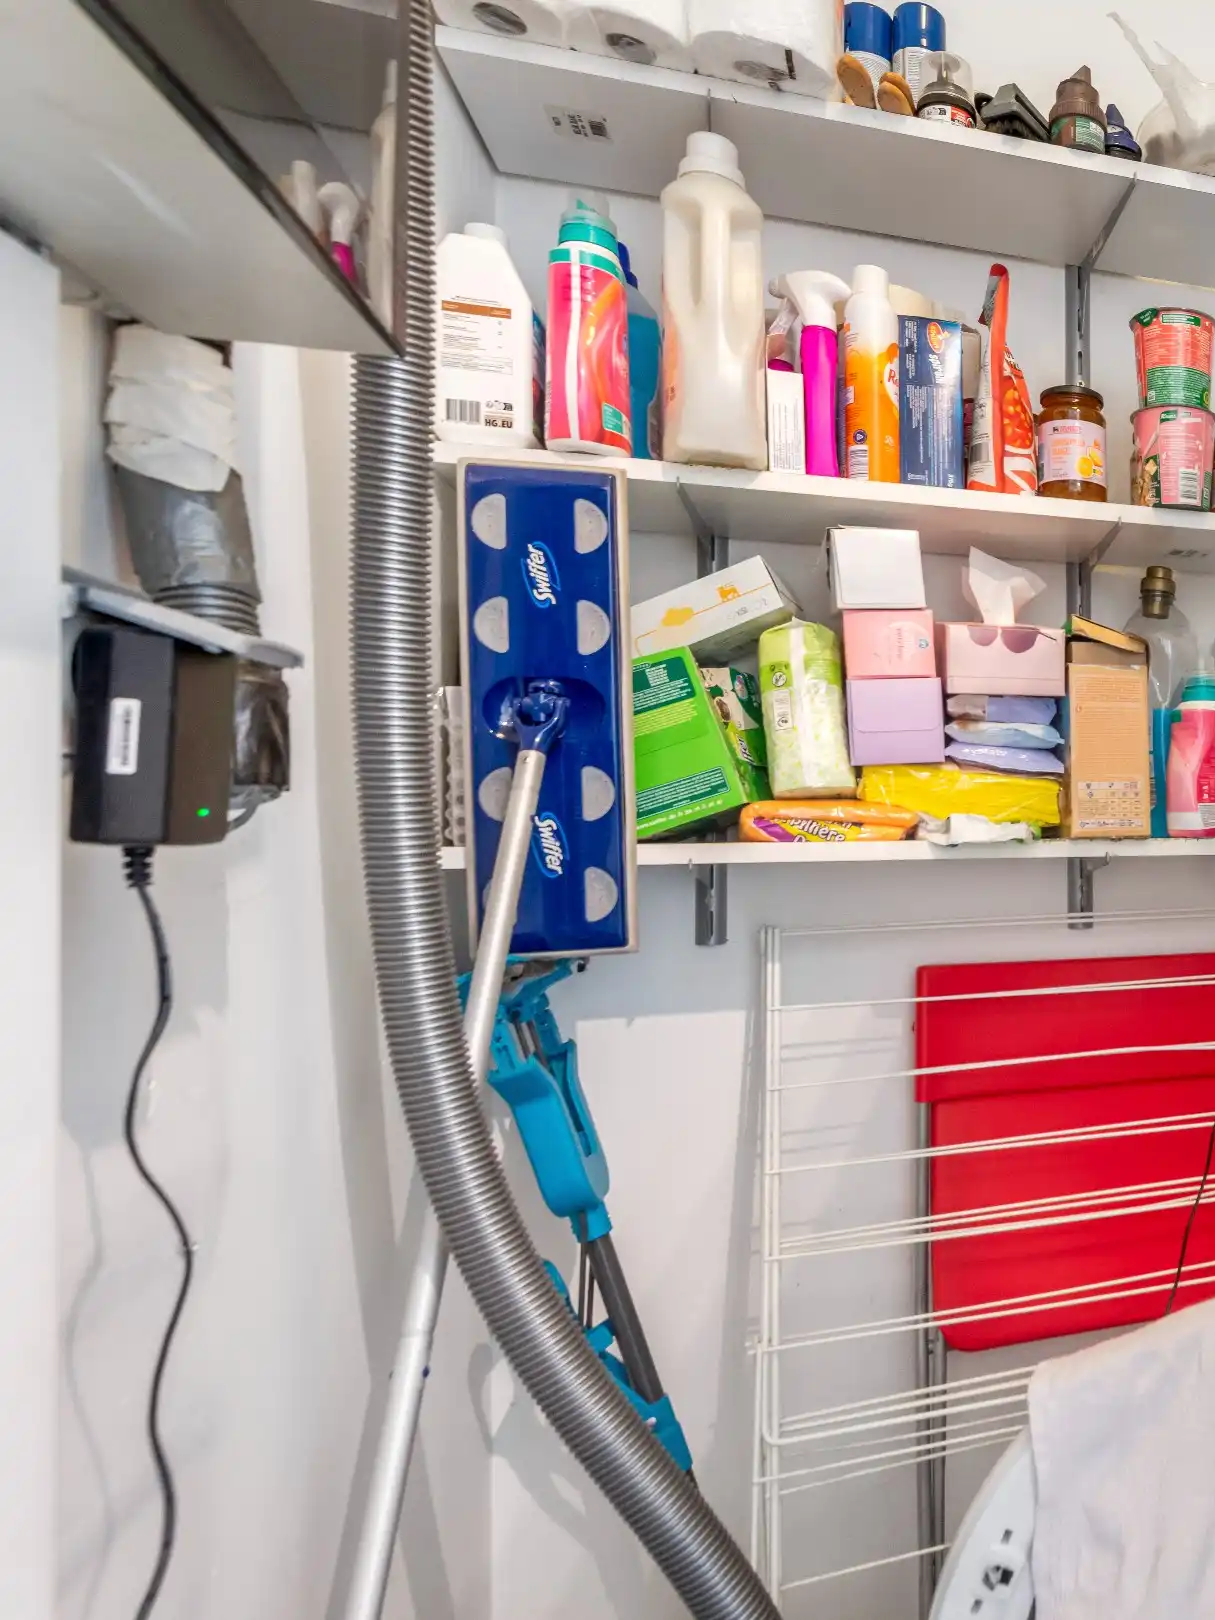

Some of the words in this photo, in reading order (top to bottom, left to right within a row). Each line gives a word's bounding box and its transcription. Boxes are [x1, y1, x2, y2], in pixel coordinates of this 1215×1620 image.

[485, 418, 513, 430] HG.EU
[527, 543, 556, 605] Swiffer
[534, 815, 563, 875] Swiffer
